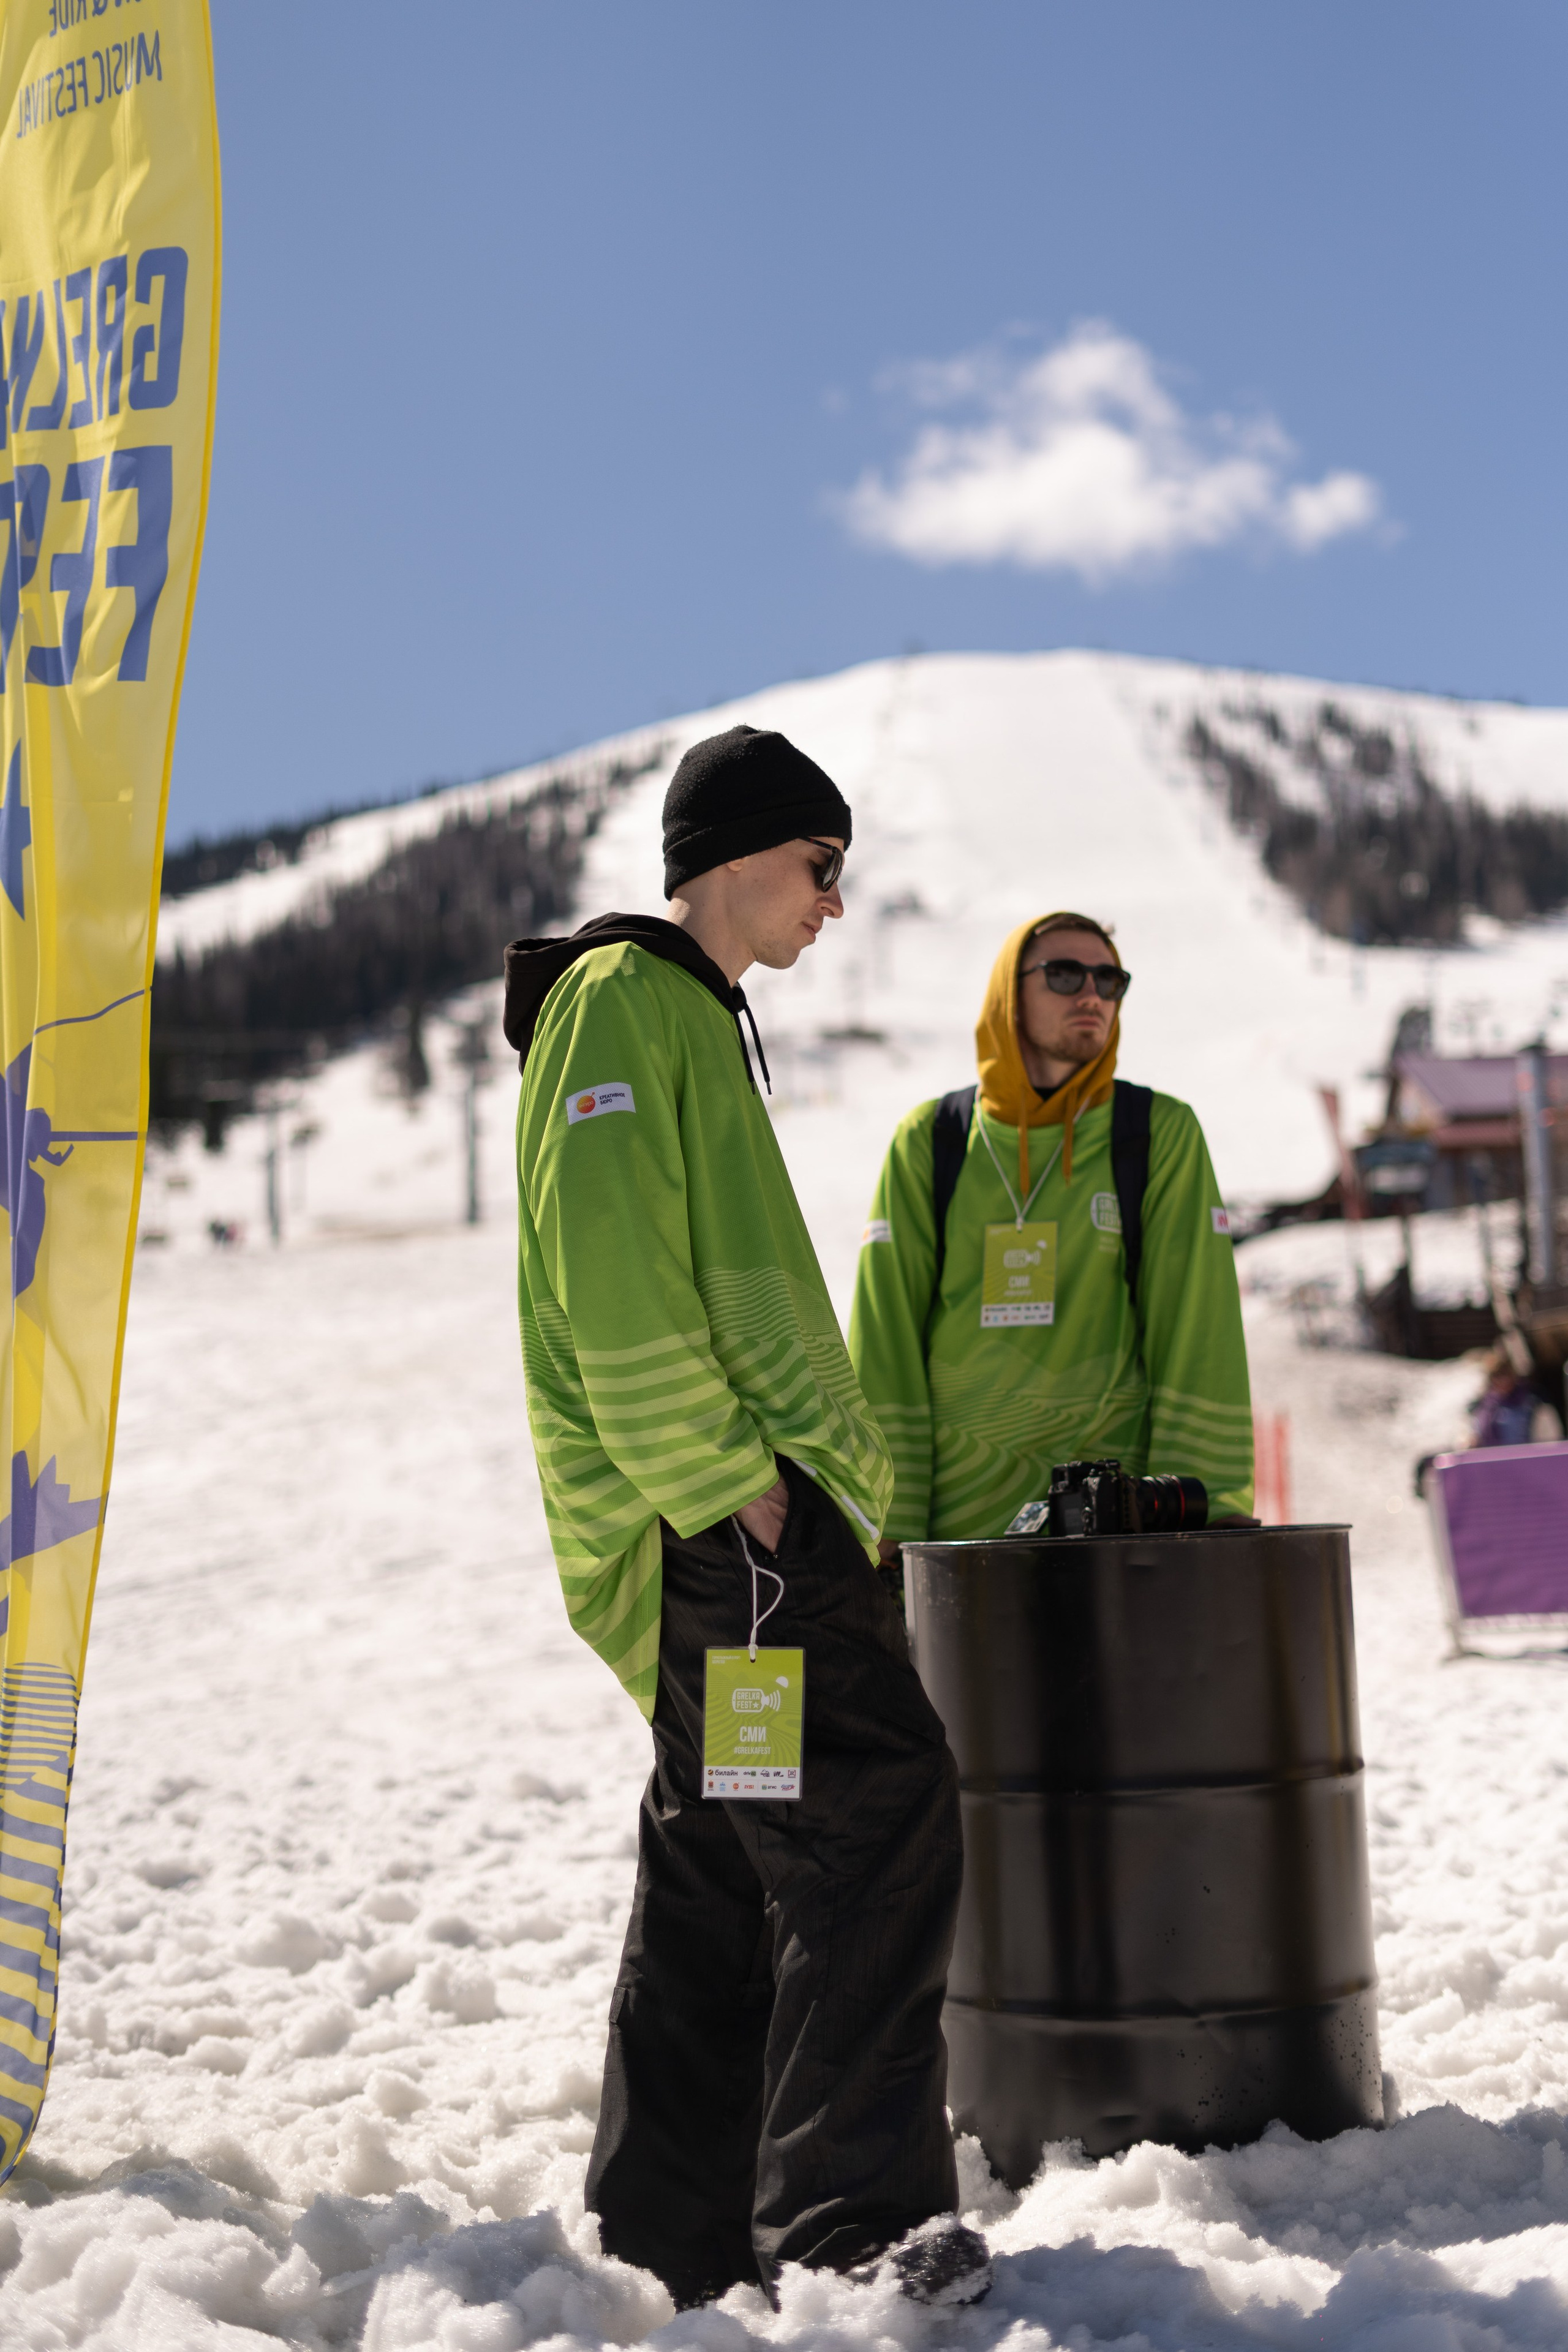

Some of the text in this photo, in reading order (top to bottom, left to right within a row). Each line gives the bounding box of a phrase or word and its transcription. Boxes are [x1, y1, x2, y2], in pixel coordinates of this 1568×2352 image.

[737, 1692, 760, 1700] GRELKA
[739, 1726, 766, 1743] СМИ
[734, 1746, 771, 1755] #GRELKAFEST
